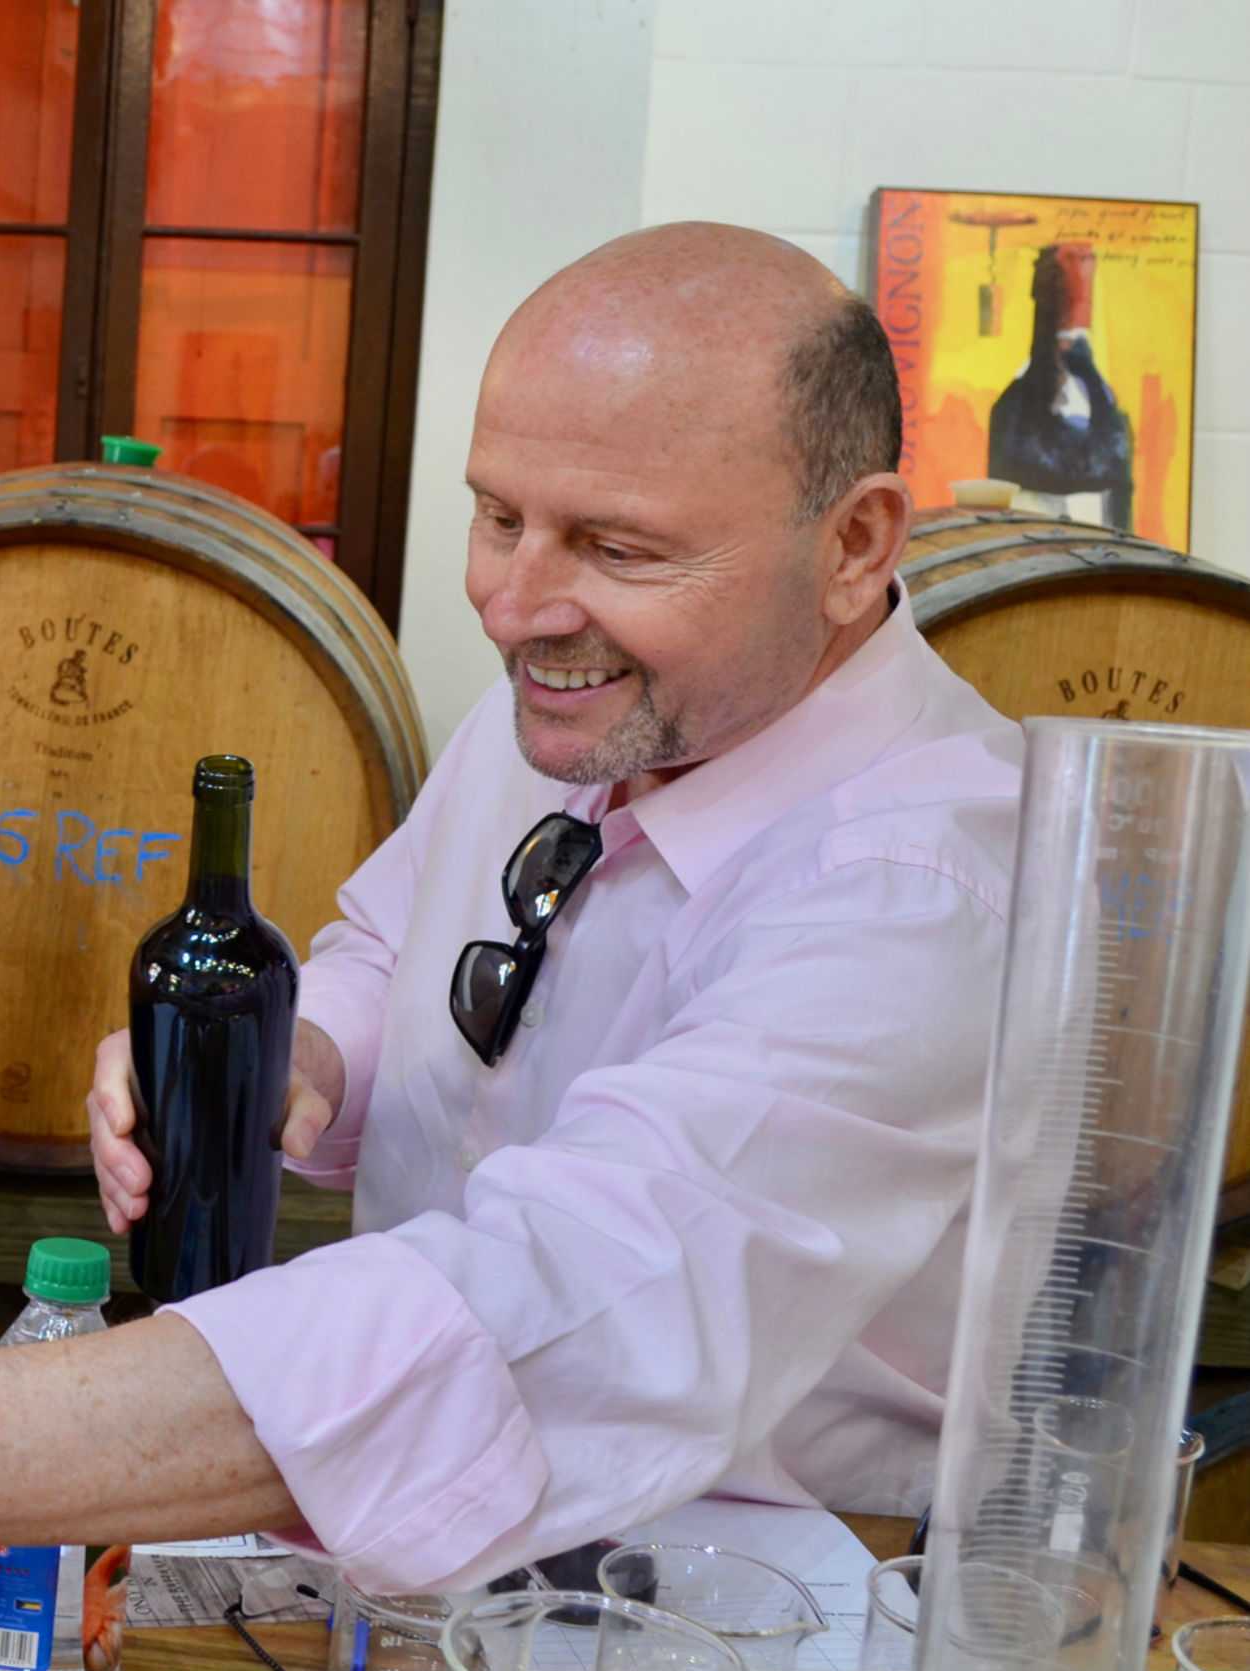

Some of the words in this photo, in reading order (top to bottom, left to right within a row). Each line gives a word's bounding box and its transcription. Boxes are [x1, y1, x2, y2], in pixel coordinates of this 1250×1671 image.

[18, 612, 139, 665] BOUTES
[1058, 666, 1186, 715] BOUTES
[54, 809, 183, 885] REF
